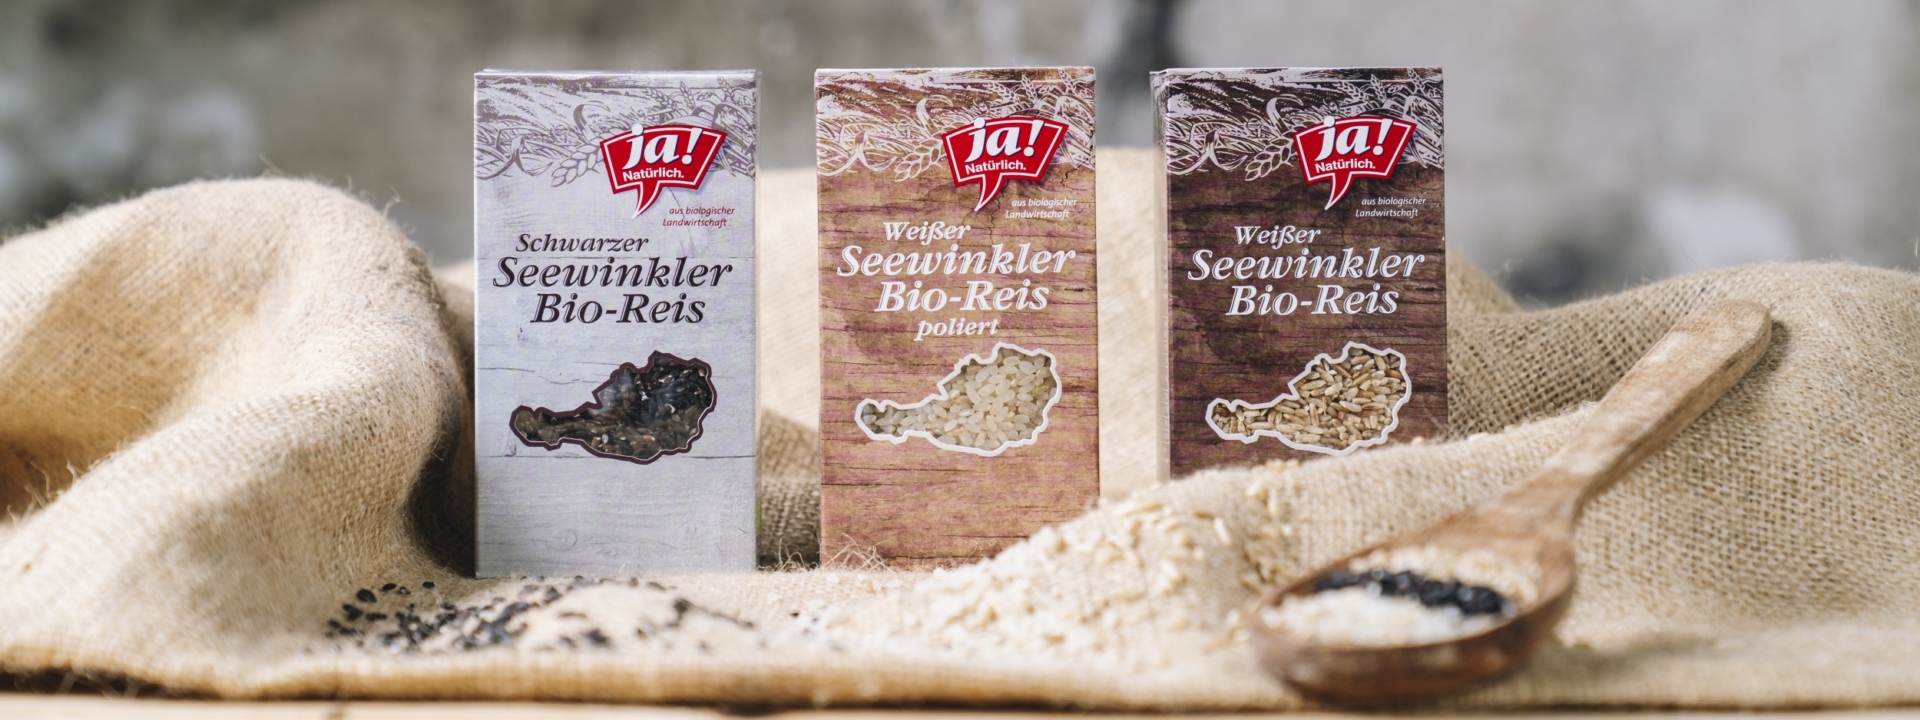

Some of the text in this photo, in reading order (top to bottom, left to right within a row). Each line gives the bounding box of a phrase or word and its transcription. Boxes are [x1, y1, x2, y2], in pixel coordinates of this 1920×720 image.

[622, 124, 702, 170] ja!
[965, 118, 1044, 163] ja!
[1315, 116, 1393, 161] ja!
[622, 167, 684, 182] Natürlich.
[965, 159, 1026, 175] Natürlich.
[1315, 158, 1375, 173] Natürlich.
[686, 206, 735, 217] biologischer
[1028, 198, 1077, 208] biologischer
[1355, 208, 1419, 218] Landwirtschaft
[1378, 196, 1426, 207] biologischer
[662, 218, 727, 228] Landwirtschaft
[1005, 210, 1070, 220] Landwirtschaft
[515, 233, 649, 252] Schwarzer
[883, 221, 971, 245] Weißer
[1234, 225, 1321, 249] Weißer
[493, 256, 732, 287] Seewinkler
[836, 243, 1076, 277] Seewinkler
[1188, 247, 1425, 281] Seewinkler
[874, 279, 1050, 312] Bio-Reis
[1226, 283, 1399, 316] Bio-Reis
[530, 293, 705, 323] Bio-Reis
[914, 318, 999, 341] poliert
